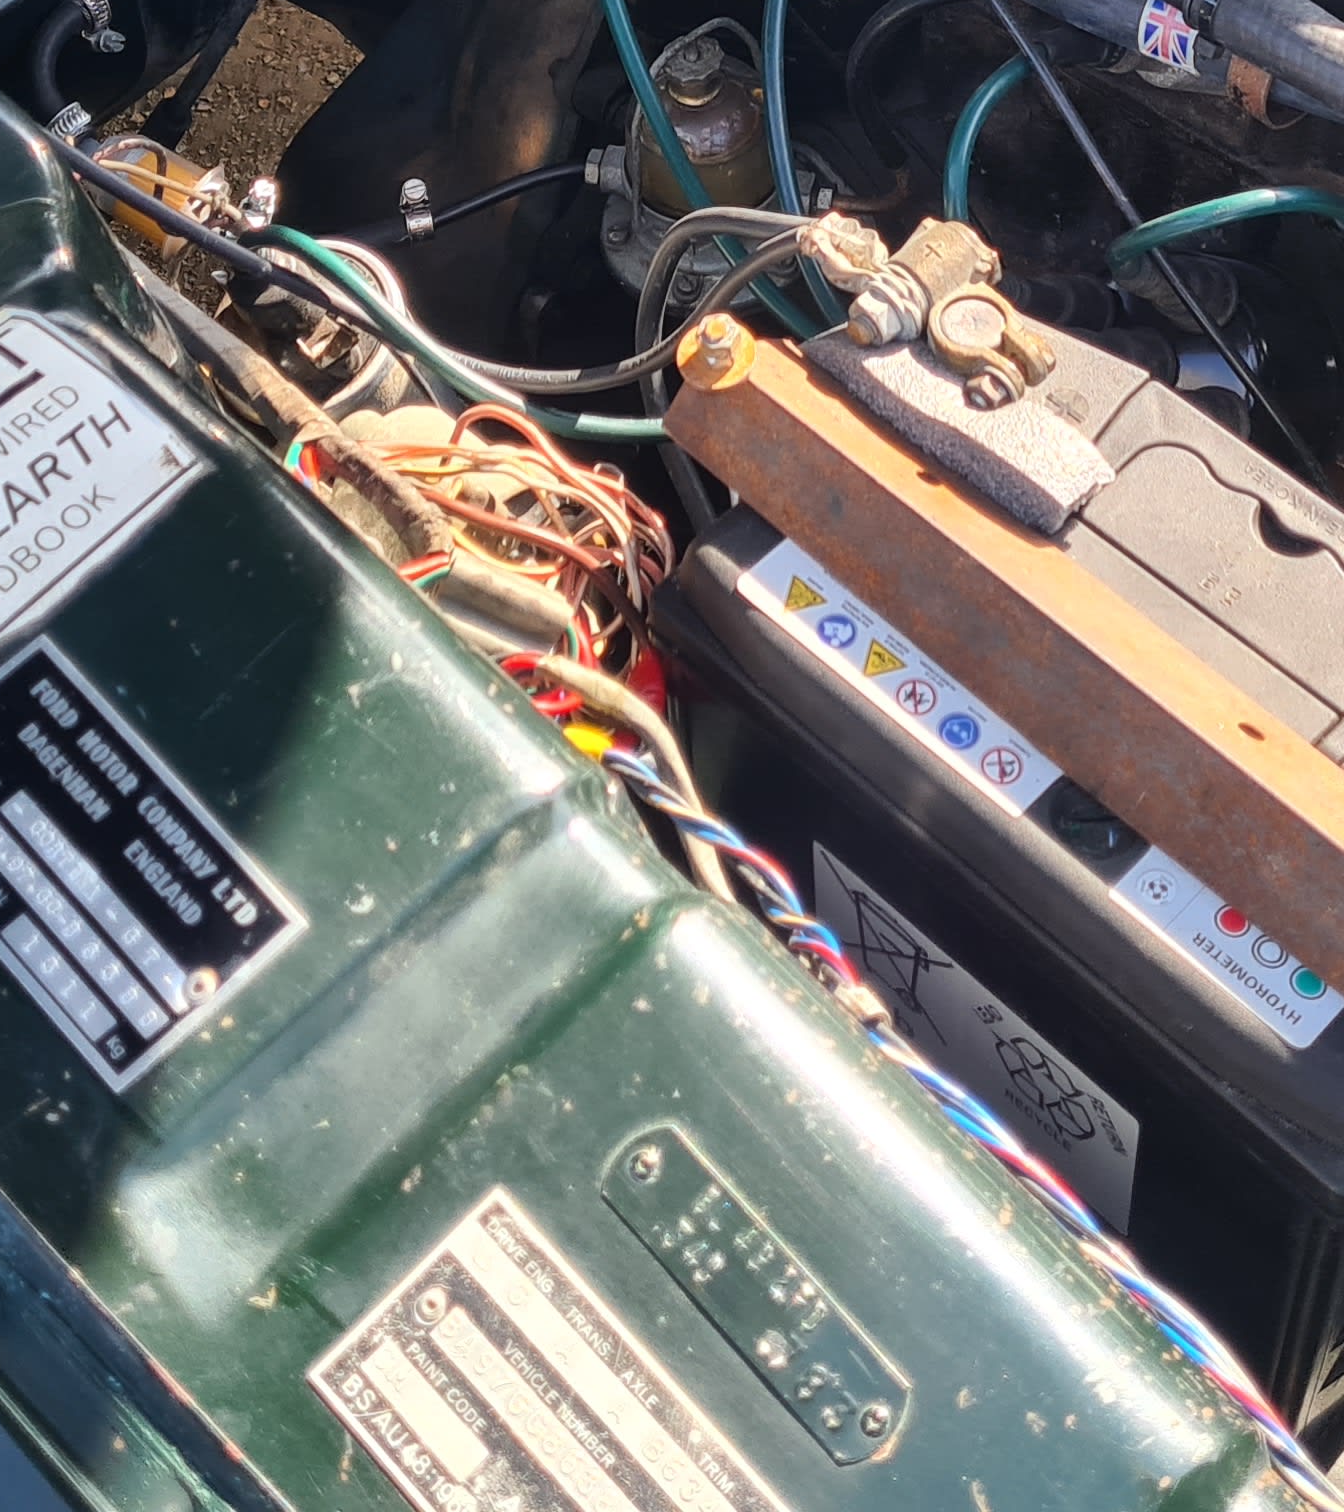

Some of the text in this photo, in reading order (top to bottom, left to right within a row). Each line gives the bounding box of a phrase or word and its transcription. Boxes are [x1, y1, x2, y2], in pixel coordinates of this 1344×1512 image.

[1244, 462, 1303, 509] KOREA
[1303, 504, 1328, 527] IN
[18, 722, 204, 928] DAGENHAM ENGLAND
[29, 677, 258, 928] FORD MOTOR COMPANY LTD
[1190, 930, 1304, 1028] HYDROMETER
[101, 1033, 129, 1062] Kg
[405, 1341, 488, 1435] PAINT CODE
[486, 1217, 528, 1263] DRIVE
[524, 1258, 556, 1299] ENG.
[562, 1305, 614, 1362] TRANS.
[620, 1370, 660, 1411] AXLE
[697, 1452, 736, 1494] TRIM
[502, 1337, 558, 1406] VEHICLE
[556, 1403, 618, 1469] NUMBER
